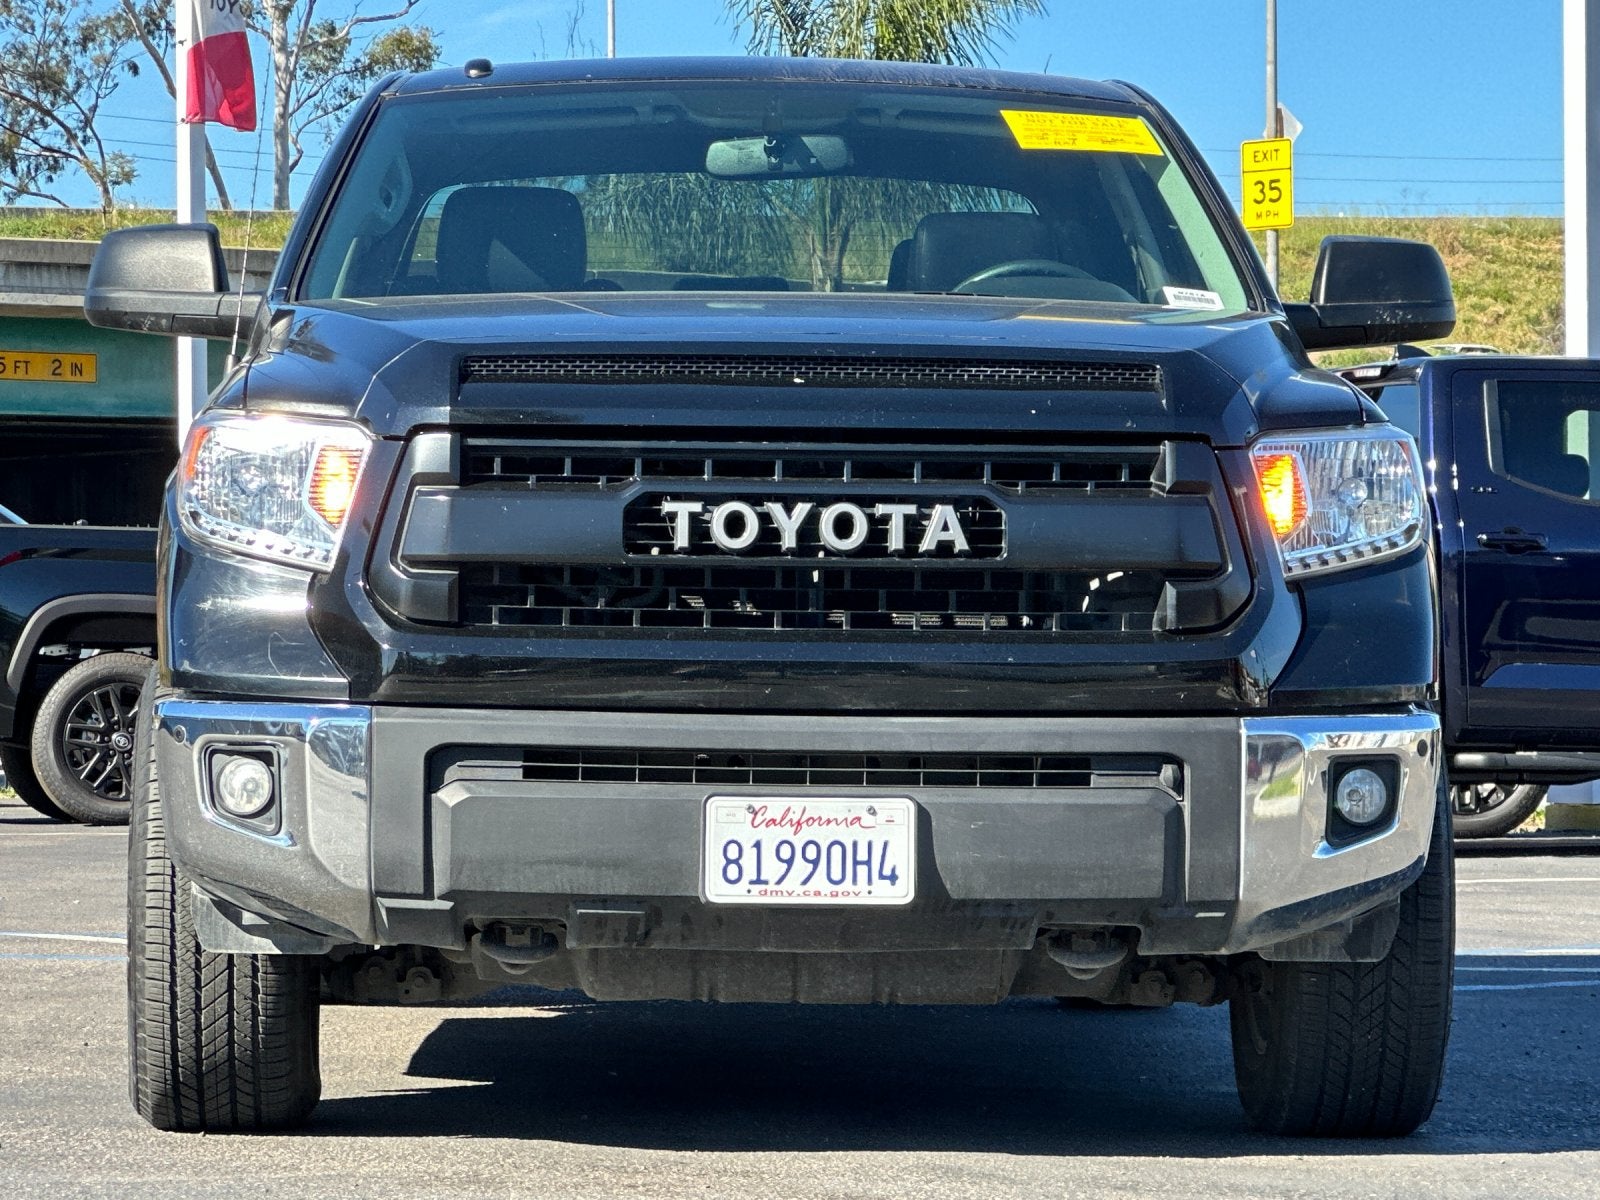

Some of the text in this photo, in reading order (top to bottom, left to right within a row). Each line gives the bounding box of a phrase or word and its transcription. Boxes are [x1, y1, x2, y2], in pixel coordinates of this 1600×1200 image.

[1253, 149, 1280, 163] EXIT
[1253, 179, 1282, 204] 35
[1256, 210, 1279, 220] MPH
[14, 360, 31, 375] FT
[51, 359, 62, 376] 2
[70, 361, 83, 377] IN
[661, 501, 971, 553] TOYOTA
[751, 805, 876, 836] California
[722, 839, 899, 888] 81990H4
[758, 888, 862, 897] dmv.ca.gov
